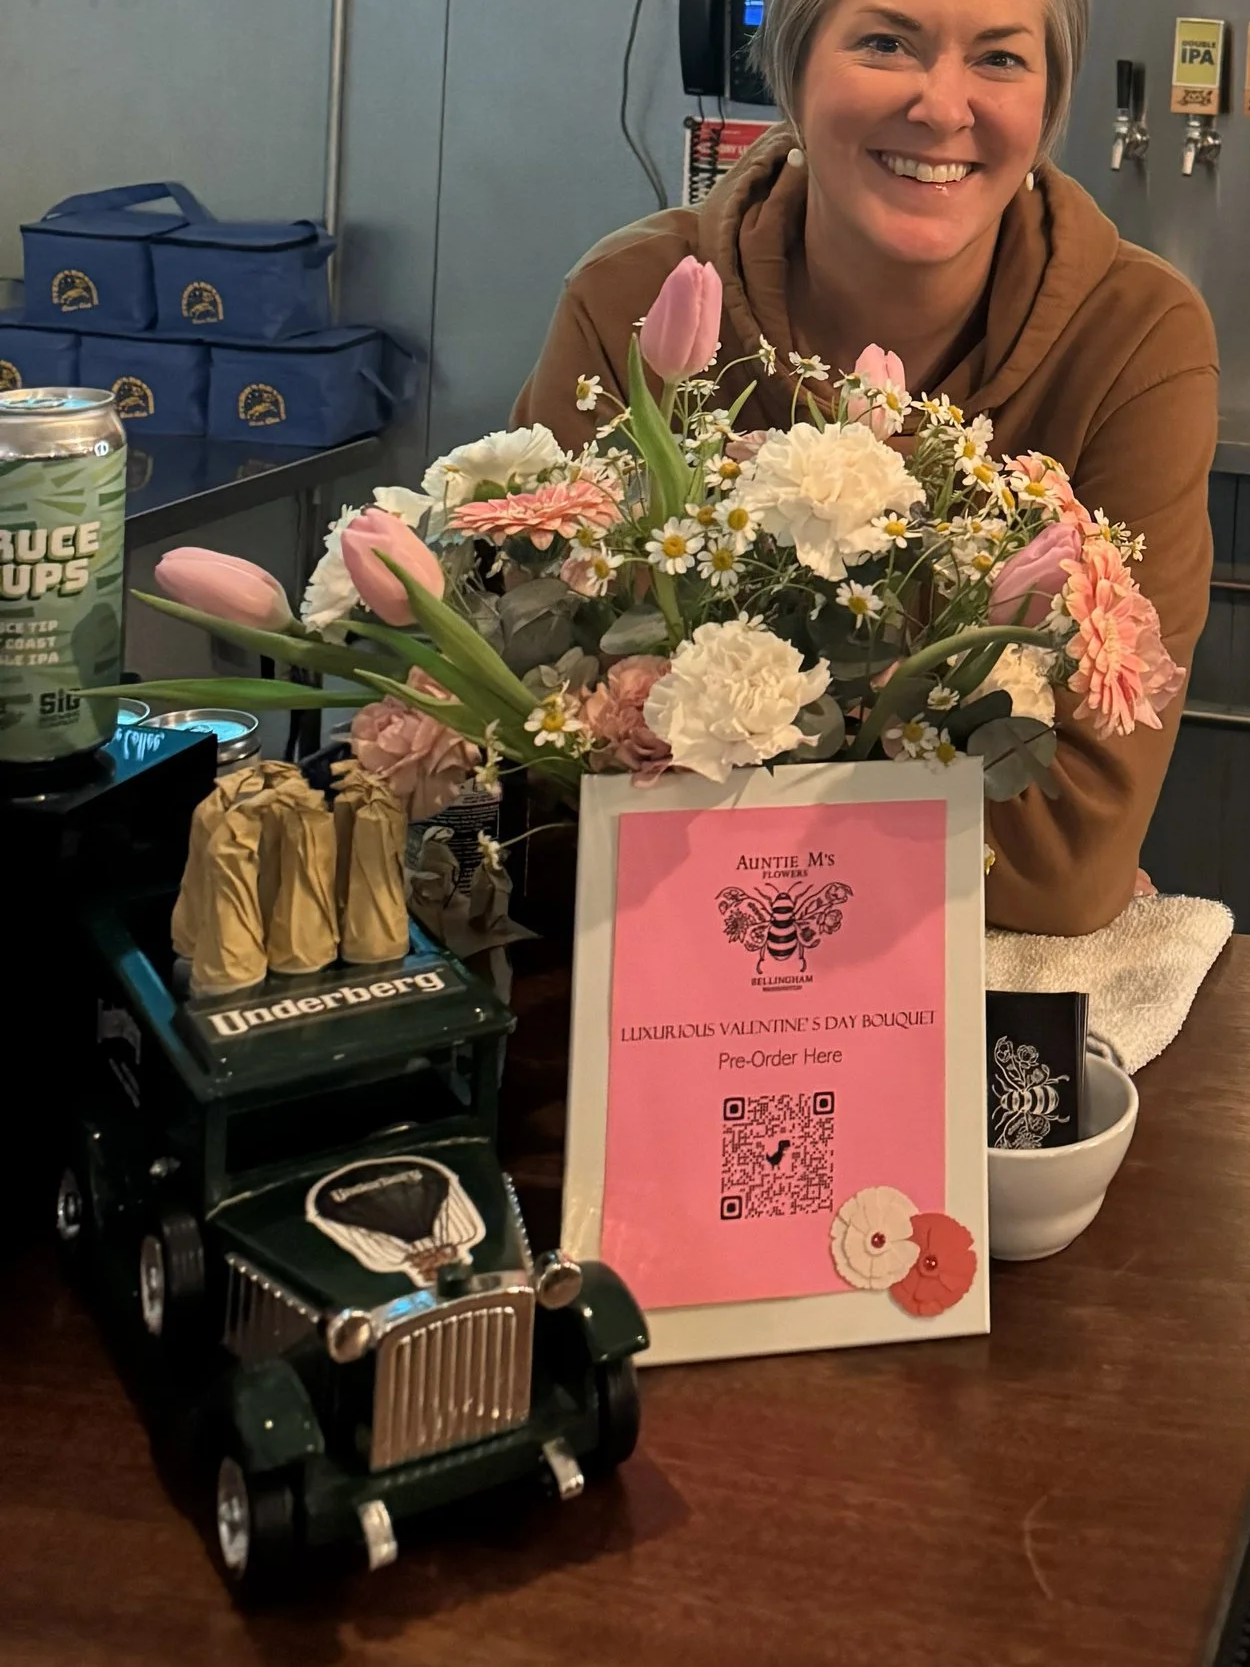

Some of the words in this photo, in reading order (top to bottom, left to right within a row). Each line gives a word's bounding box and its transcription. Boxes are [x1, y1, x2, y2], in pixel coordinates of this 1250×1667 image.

[1182, 40, 1217, 49] DOUBLE
[1181, 48, 1215, 66] IPA
[5, 636, 56, 650] COAST
[736, 854, 799, 871] AUNTIE
[762, 869, 808, 879] FLOWERS
[751, 974, 814, 987] BELLINGHAM
[207, 972, 446, 1036] Underberg
[621, 1021, 716, 1042] LUXURIOUS
[824, 1014, 858, 1031] DAY
[862, 1010, 937, 1030] BOUQUET
[718, 1050, 798, 1070] Pre-Order
[804, 1048, 843, 1065] Here
